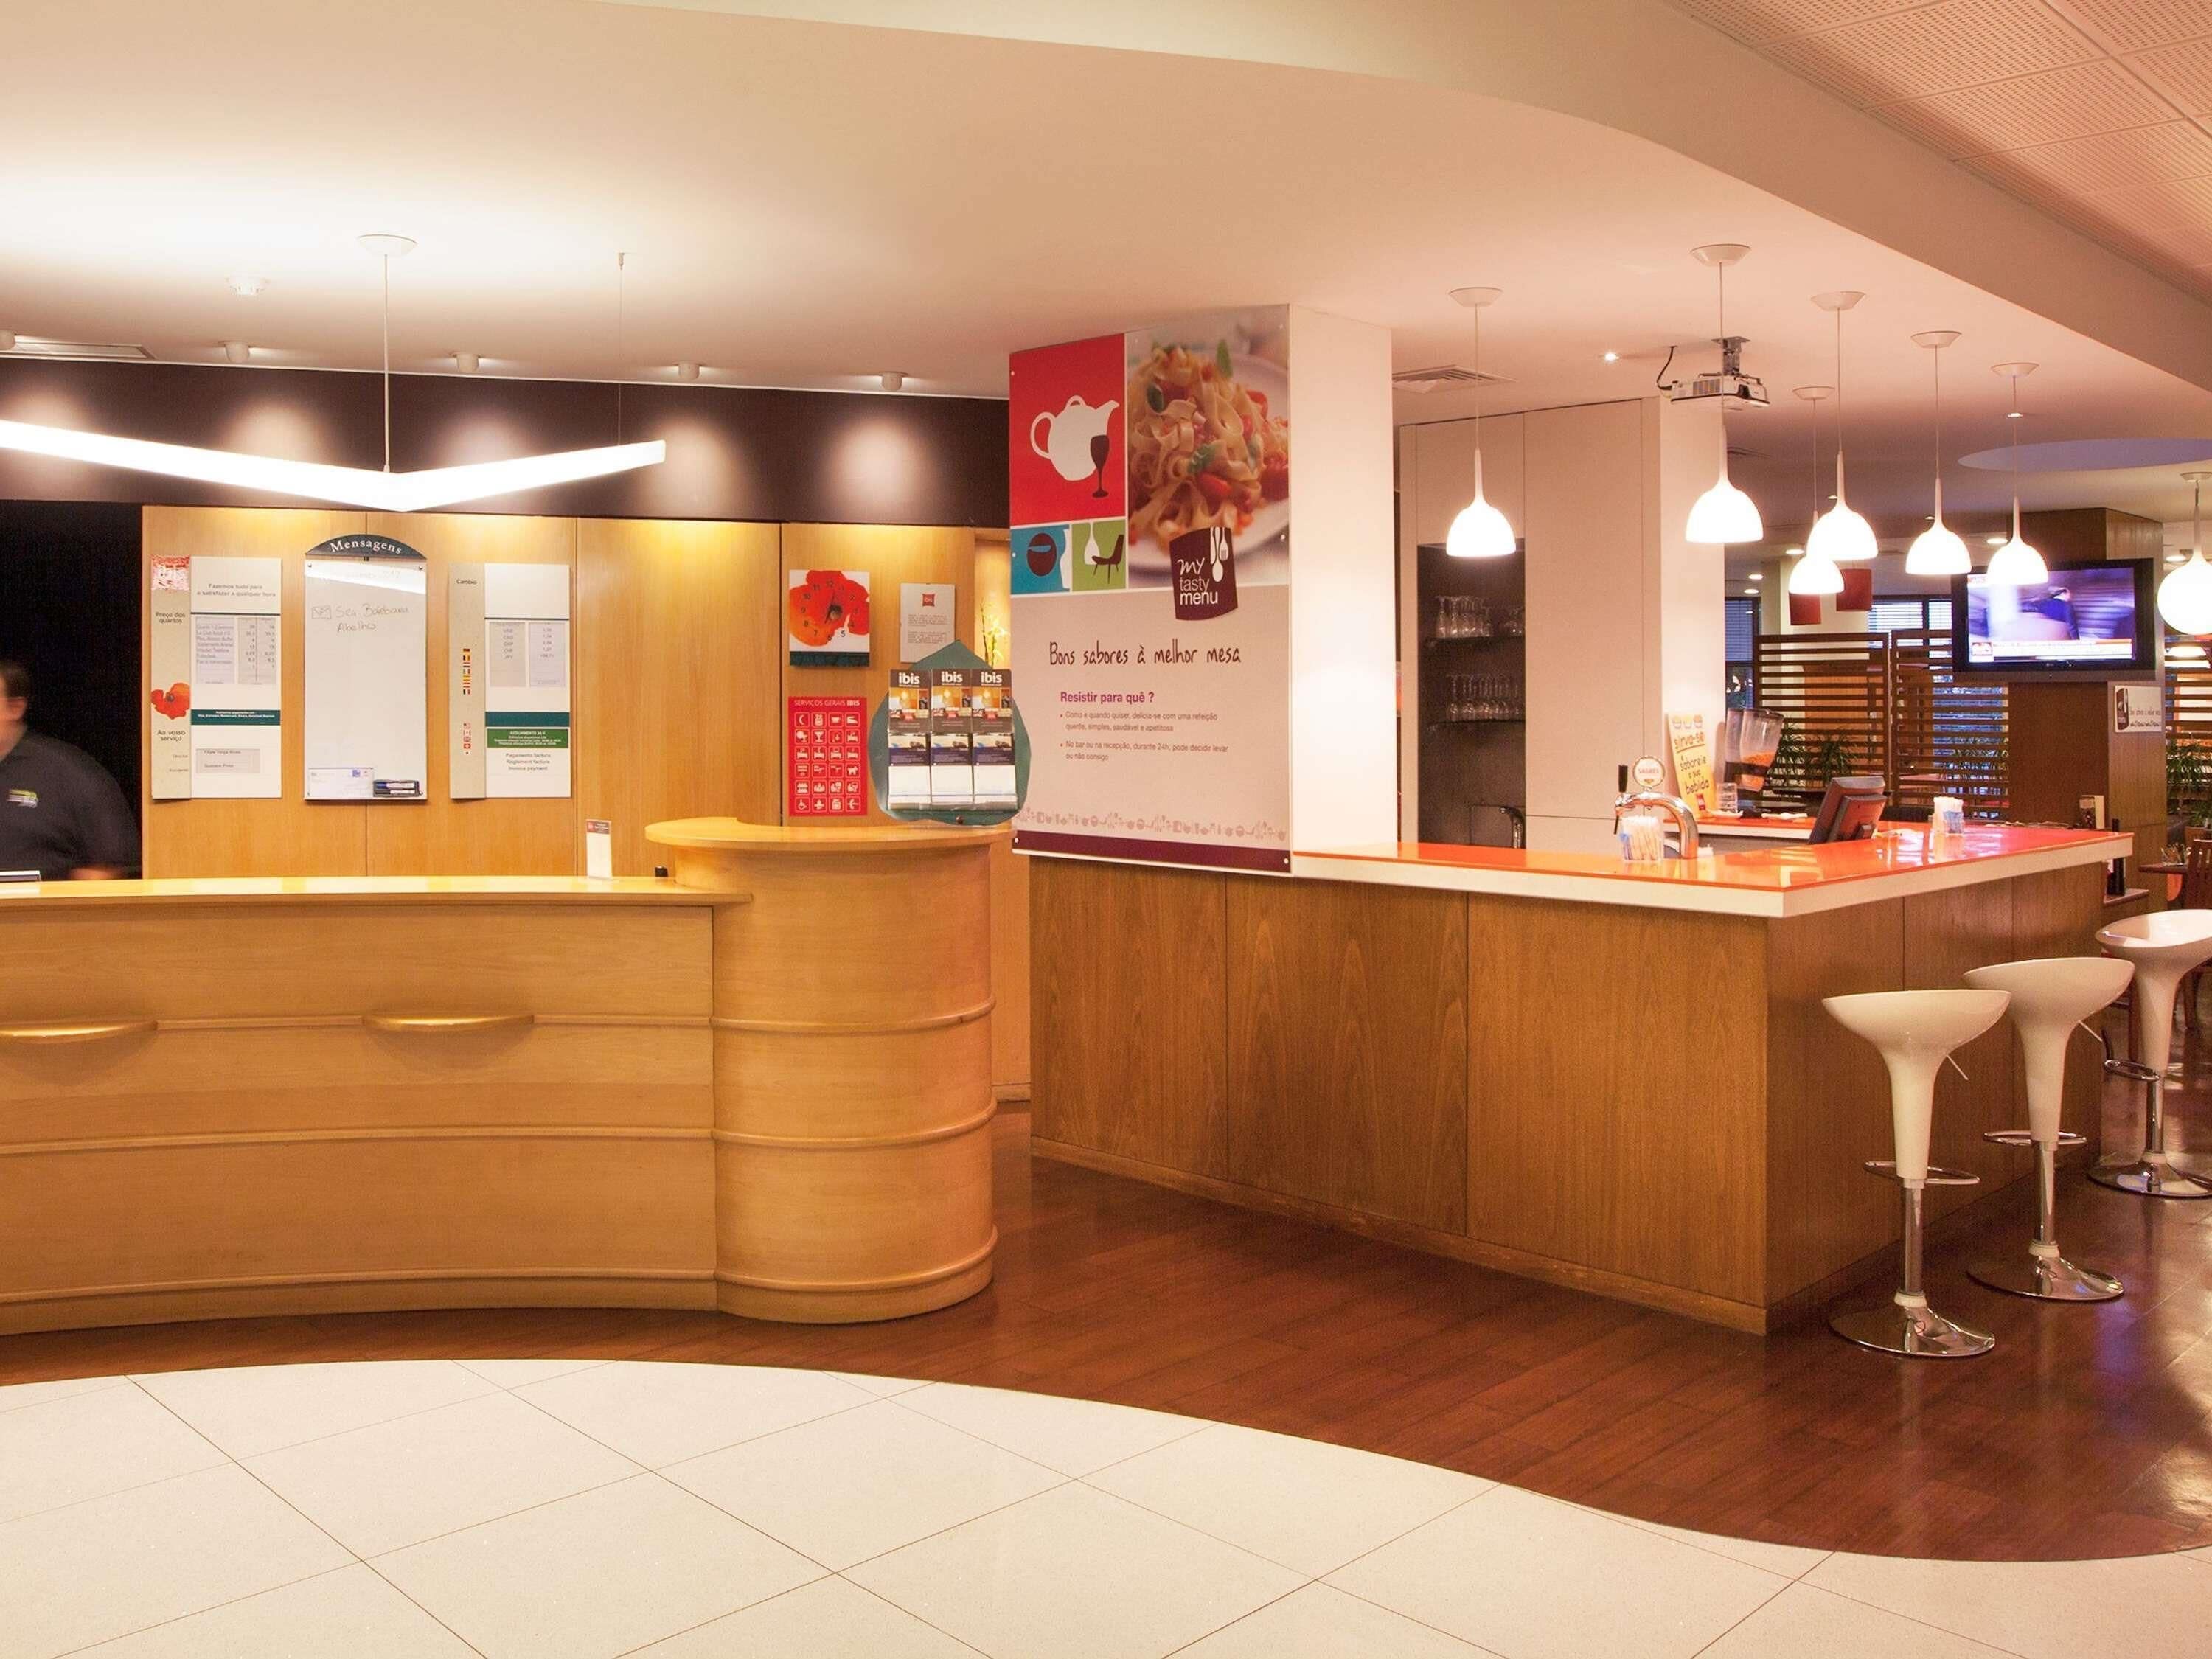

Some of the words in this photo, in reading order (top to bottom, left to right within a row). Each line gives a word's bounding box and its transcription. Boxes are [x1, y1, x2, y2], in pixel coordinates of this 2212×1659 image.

[330, 540, 402, 554] Mensagens
[1177, 557, 1206, 576] my
[1180, 575, 1210, 594] tasty
[1180, 591, 1218, 605] menu
[1050, 641, 1075, 665] Bons
[1083, 640, 1128, 665] sabores
[1137, 644, 1146, 664] à
[1154, 639, 1198, 664] melhor
[1206, 646, 1242, 664] mesa
[899, 672, 920, 685] ibis
[941, 671, 963, 683] ibis
[981, 672, 1003, 684] ibis
[794, 699, 824, 707] SERVIÇOS
[1060, 692, 1098, 703] Resistir
[1101, 693, 1123, 704] para
[1126, 692, 1145, 705] quê
[1148, 692, 1155, 703] ?
[1192, 712, 1217, 722] refeição
[1172, 744, 1188, 752] pode
